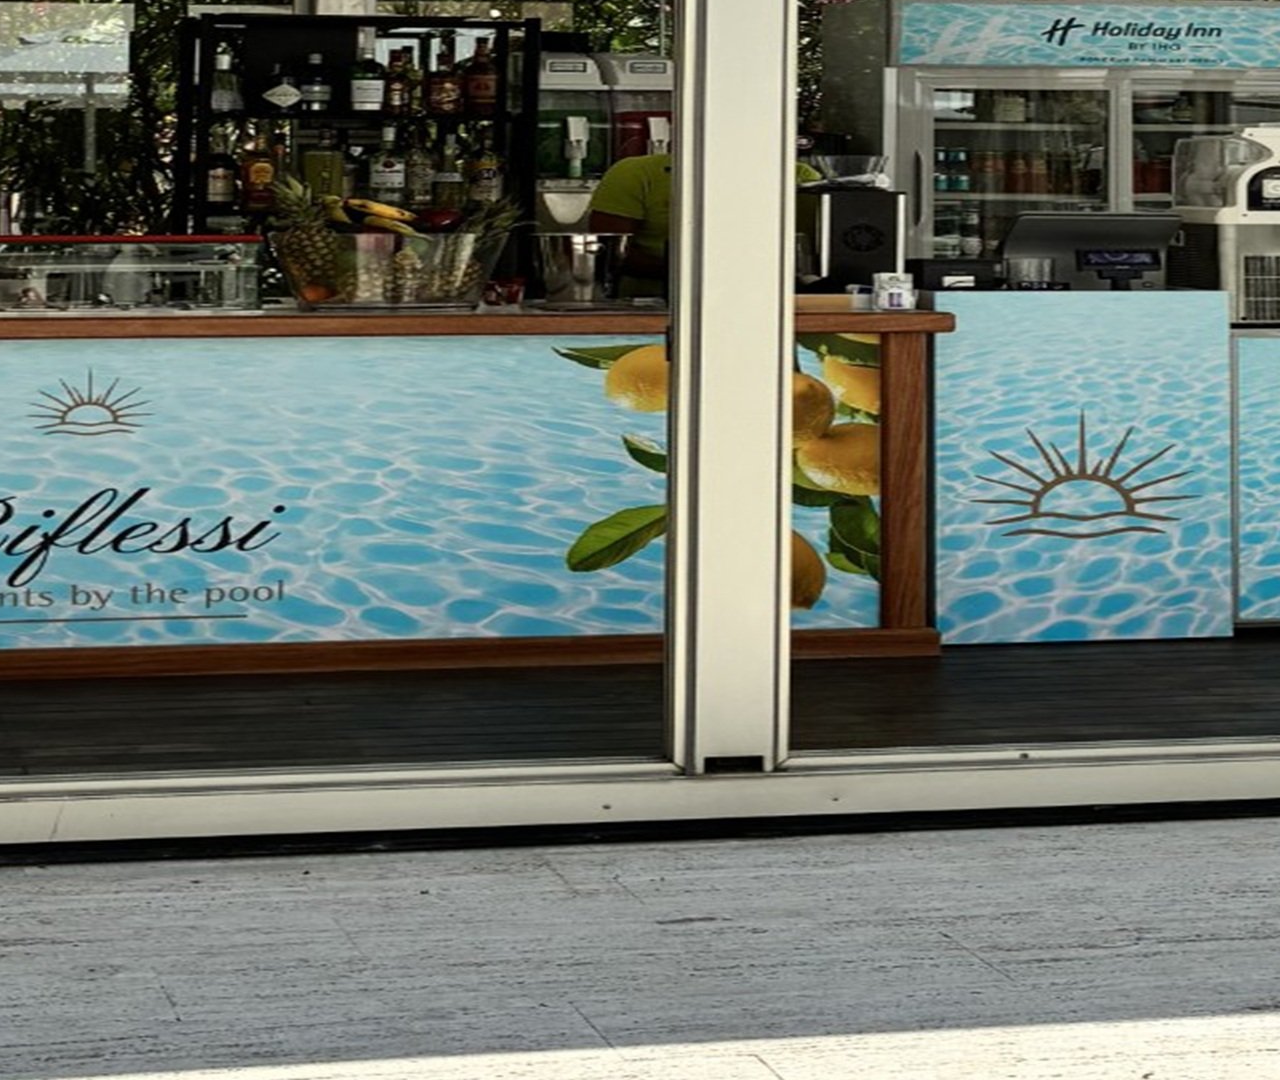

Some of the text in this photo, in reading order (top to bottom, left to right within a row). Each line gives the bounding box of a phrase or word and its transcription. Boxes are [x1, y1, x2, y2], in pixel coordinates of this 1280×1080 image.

[1091, 21, 1223, 41] Holiday Inn
[70, 584, 115, 612] by
[129, 581, 190, 606] the
[203, 579, 284, 609] pool
